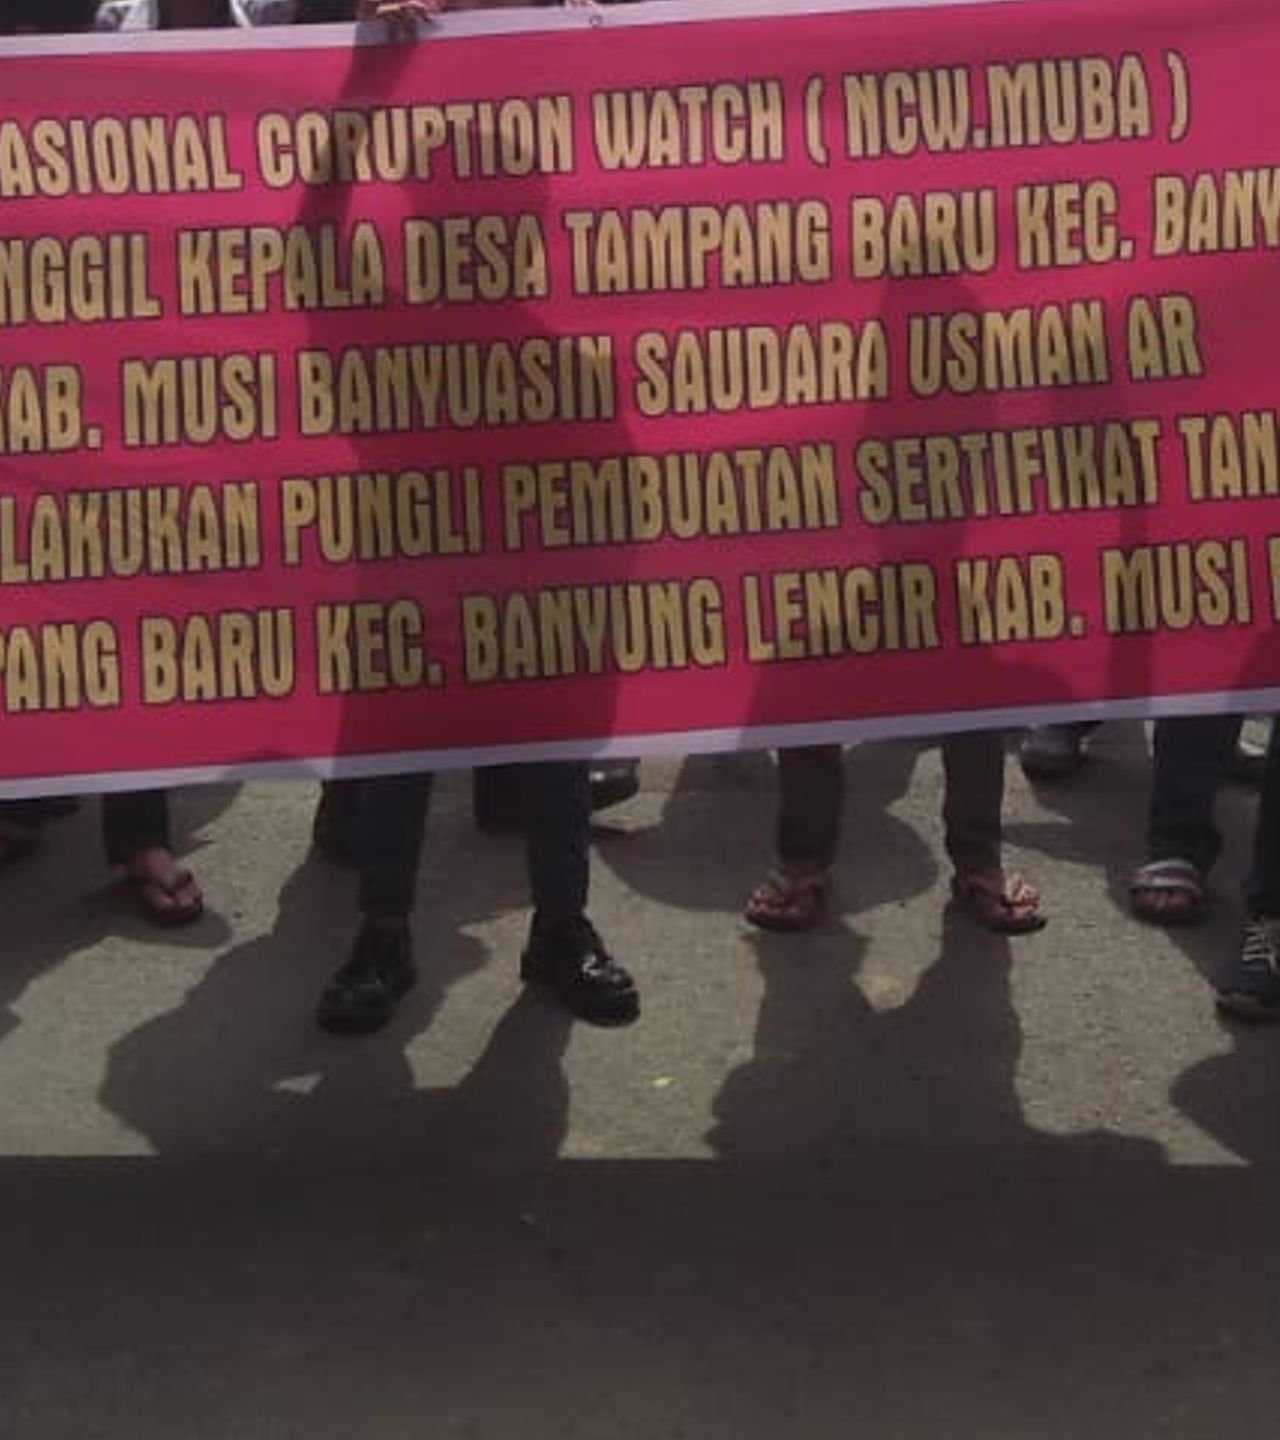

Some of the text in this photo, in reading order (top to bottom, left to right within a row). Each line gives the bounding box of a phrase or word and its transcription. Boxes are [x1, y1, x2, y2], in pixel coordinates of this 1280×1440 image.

[258, 95, 574, 188] CORUPTION
[591, 80, 785, 170] WATCH
[844, 52, 1152, 157] NCW.MUBA
[178, 221, 385, 317] KEPALA
[404, 209, 549, 304] DESA
[565, 199, 831, 295] TAMPANG
[852, 187, 996, 282] BARU
[1015, 180, 1136, 269] KEC.
[122, 352, 278, 448] MUSI
[299, 334, 616, 436] BANYUASIN
[636, 320, 890, 417] SAUDARA
[909, 301, 1110, 398] USMAN
[1127, 295, 1203, 381] AR
[282, 467, 482, 565] PUNGLI
[503, 444, 840, 550] PEMBUATAN
[856, 420, 1162, 527] SERTIFIKAT
[141, 608, 295, 706] BARU
[315, 600, 444, 694] KEC.
[462, 577, 724, 689] BANYUNG
[743, 564, 938, 664] LENCIR
[956, 553, 1086, 646] KAB.
[1103, 539, 1252, 634] MUSI
